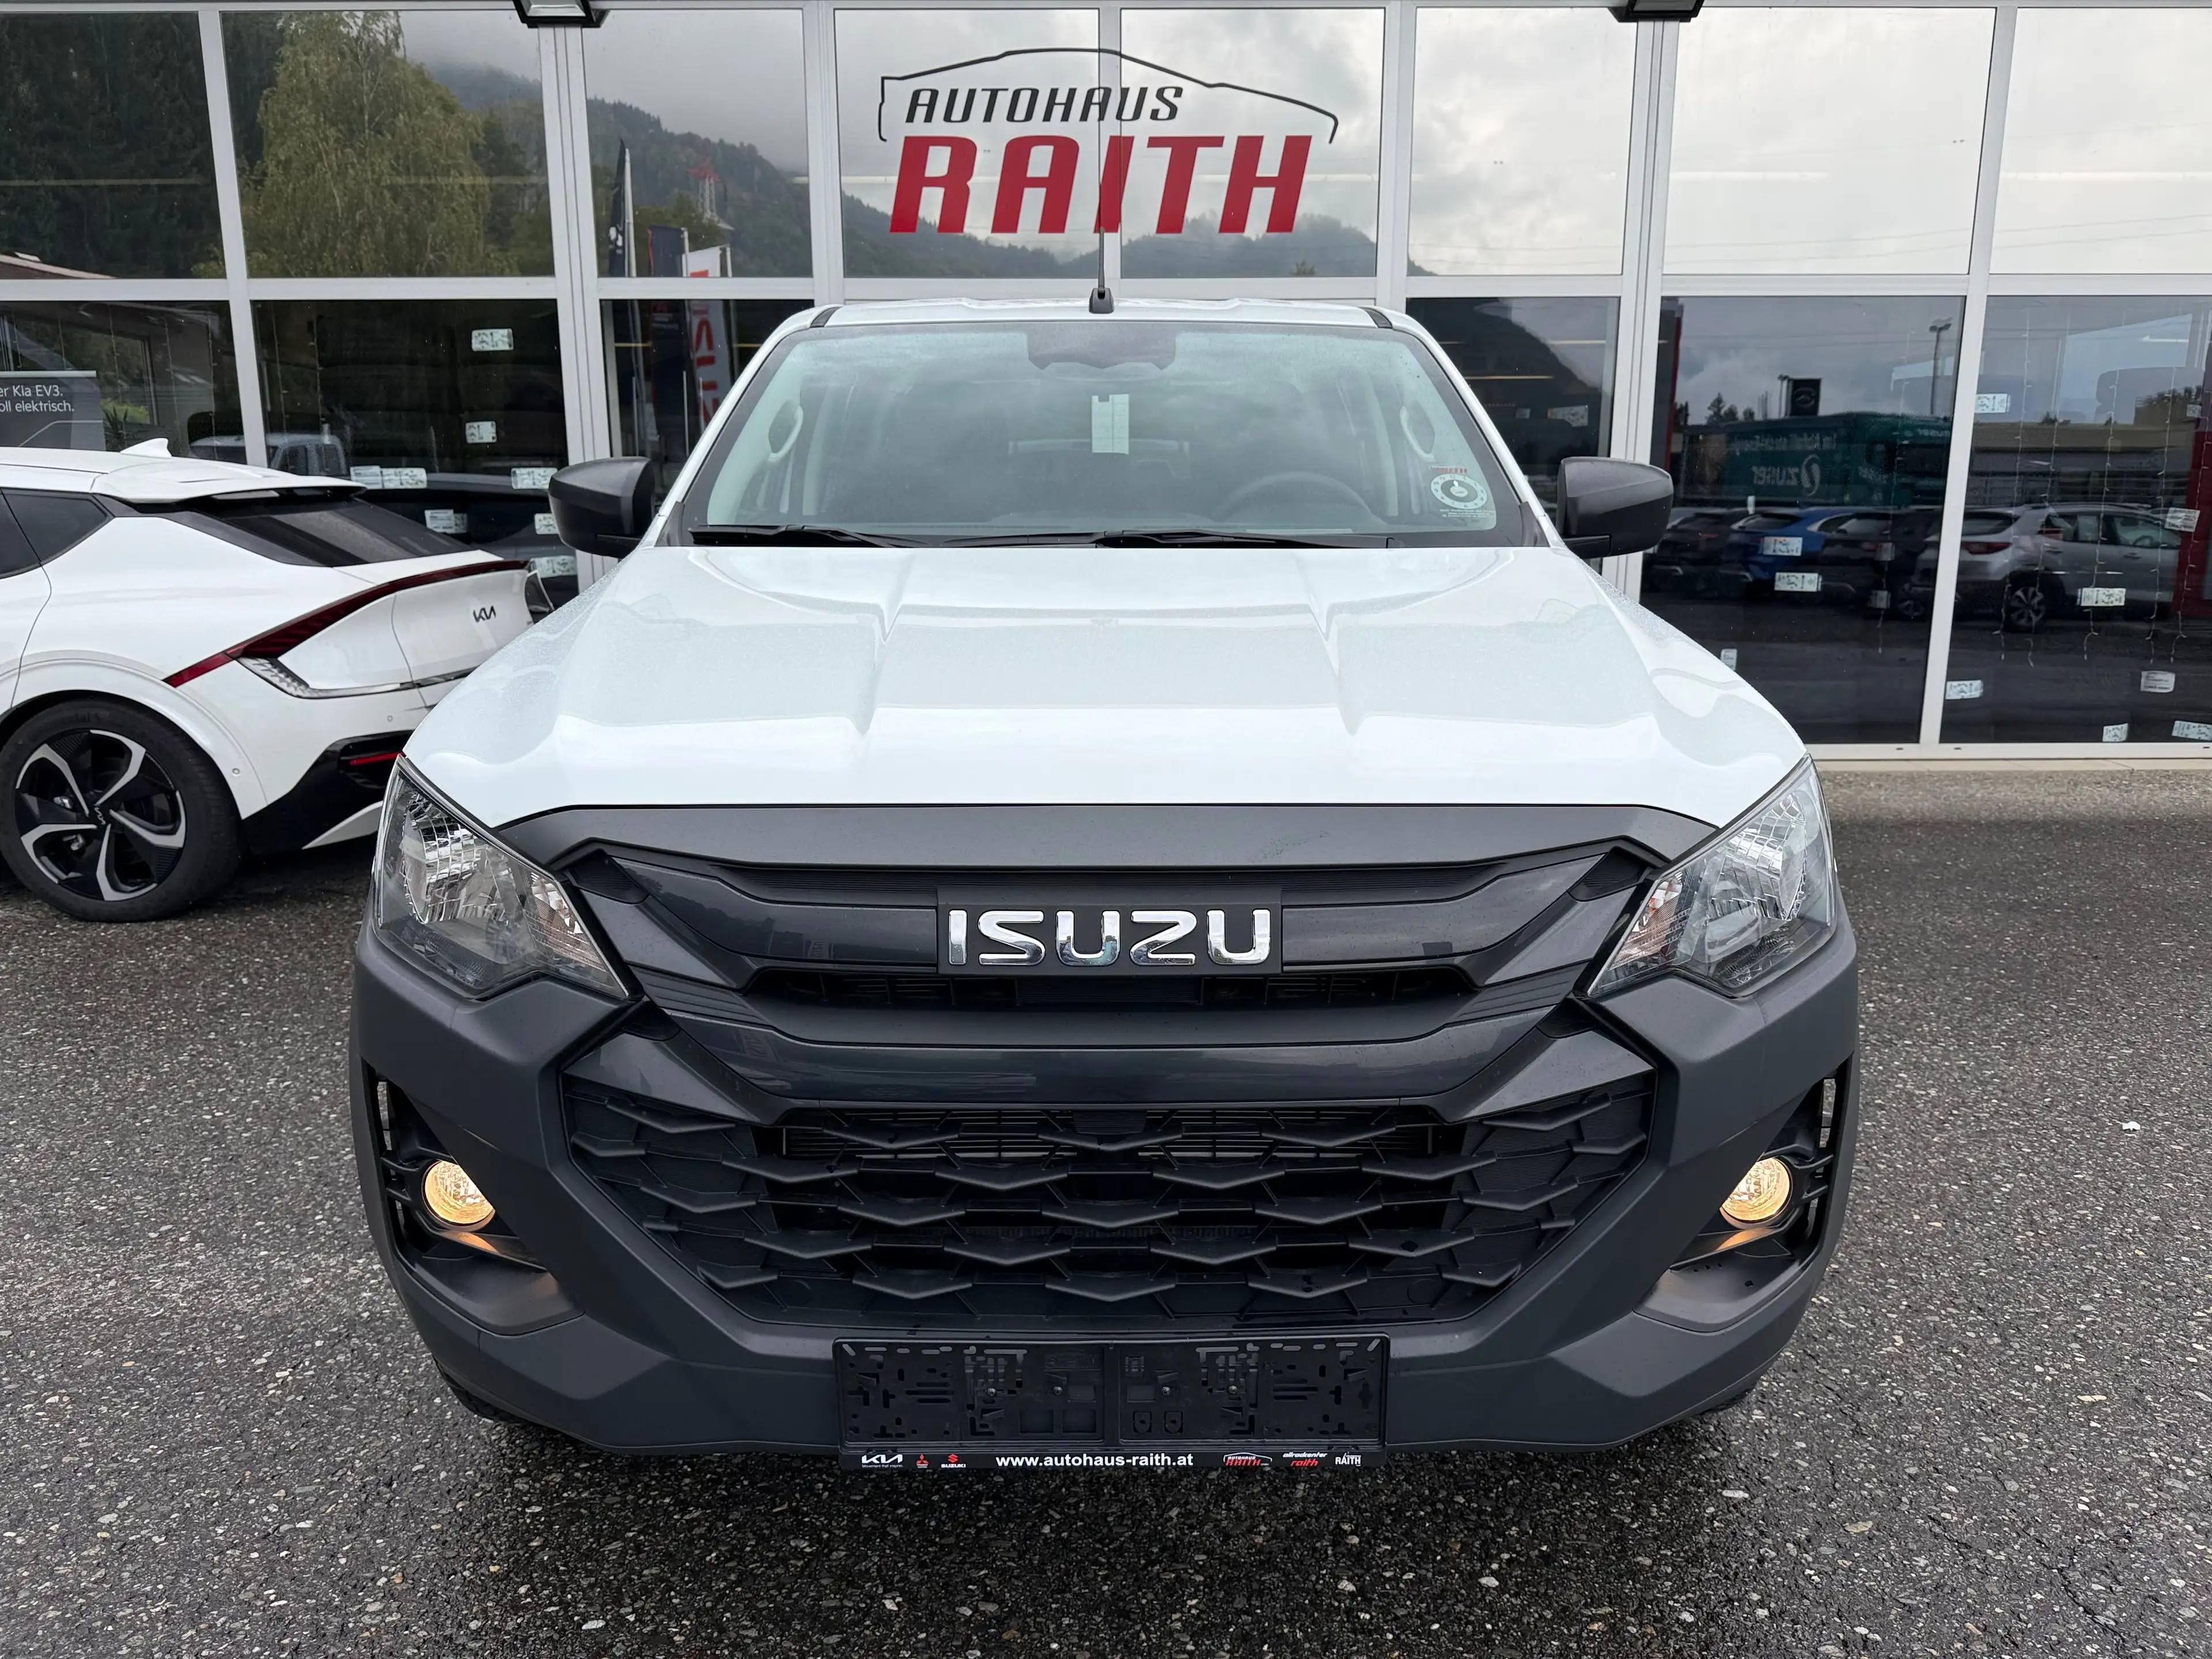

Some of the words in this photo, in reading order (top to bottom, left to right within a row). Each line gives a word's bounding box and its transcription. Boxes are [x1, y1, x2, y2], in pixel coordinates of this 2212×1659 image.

[905, 86, 1183, 123] AUTOHAUS
[889, 134, 1312, 234] RAITH
[13, 384, 32, 397] Kia
[35, 384, 63, 397] EV3.
[15, 400, 74, 412] elektrisch.
[949, 910, 1271, 966] ISUZU
[995, 1453, 1194, 1466] www.autohaus-raith.at
[1335, 1453, 1361, 1464] RAITH
